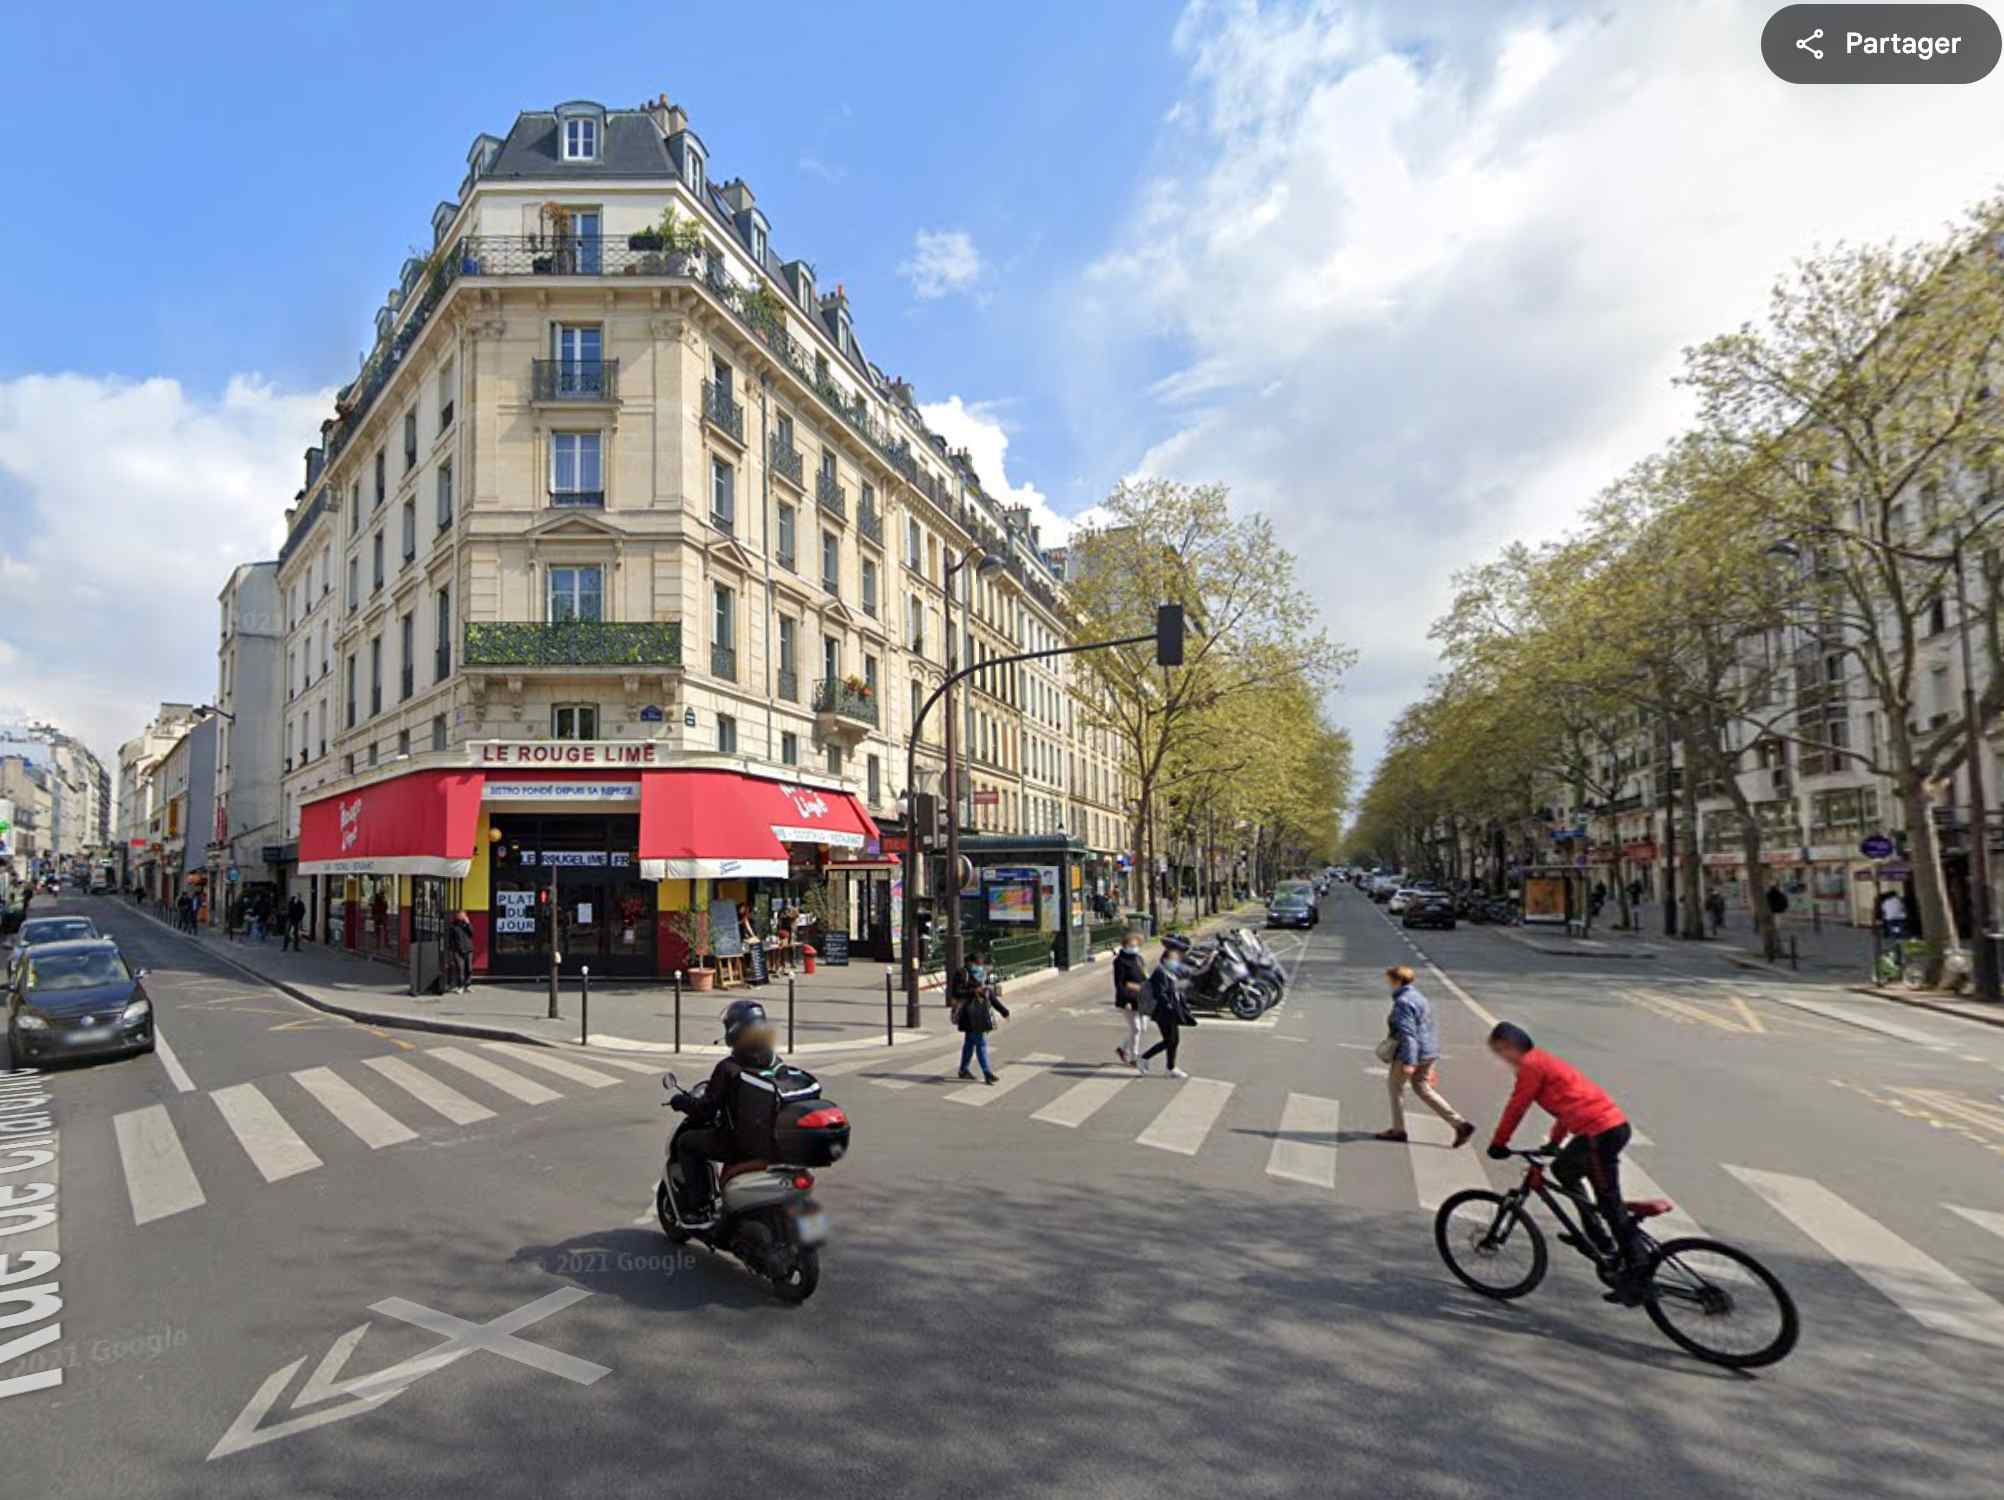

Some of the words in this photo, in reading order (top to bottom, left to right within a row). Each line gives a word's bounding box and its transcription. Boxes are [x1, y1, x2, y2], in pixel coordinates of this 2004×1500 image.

[483, 746, 508, 761] LE
[517, 746, 595, 762] ROUGE
[555, 786, 585, 796] DEPUIS
[497, 894, 534, 905] PLAT
[506, 907, 526, 917] DU
[497, 920, 534, 931] JOUR
